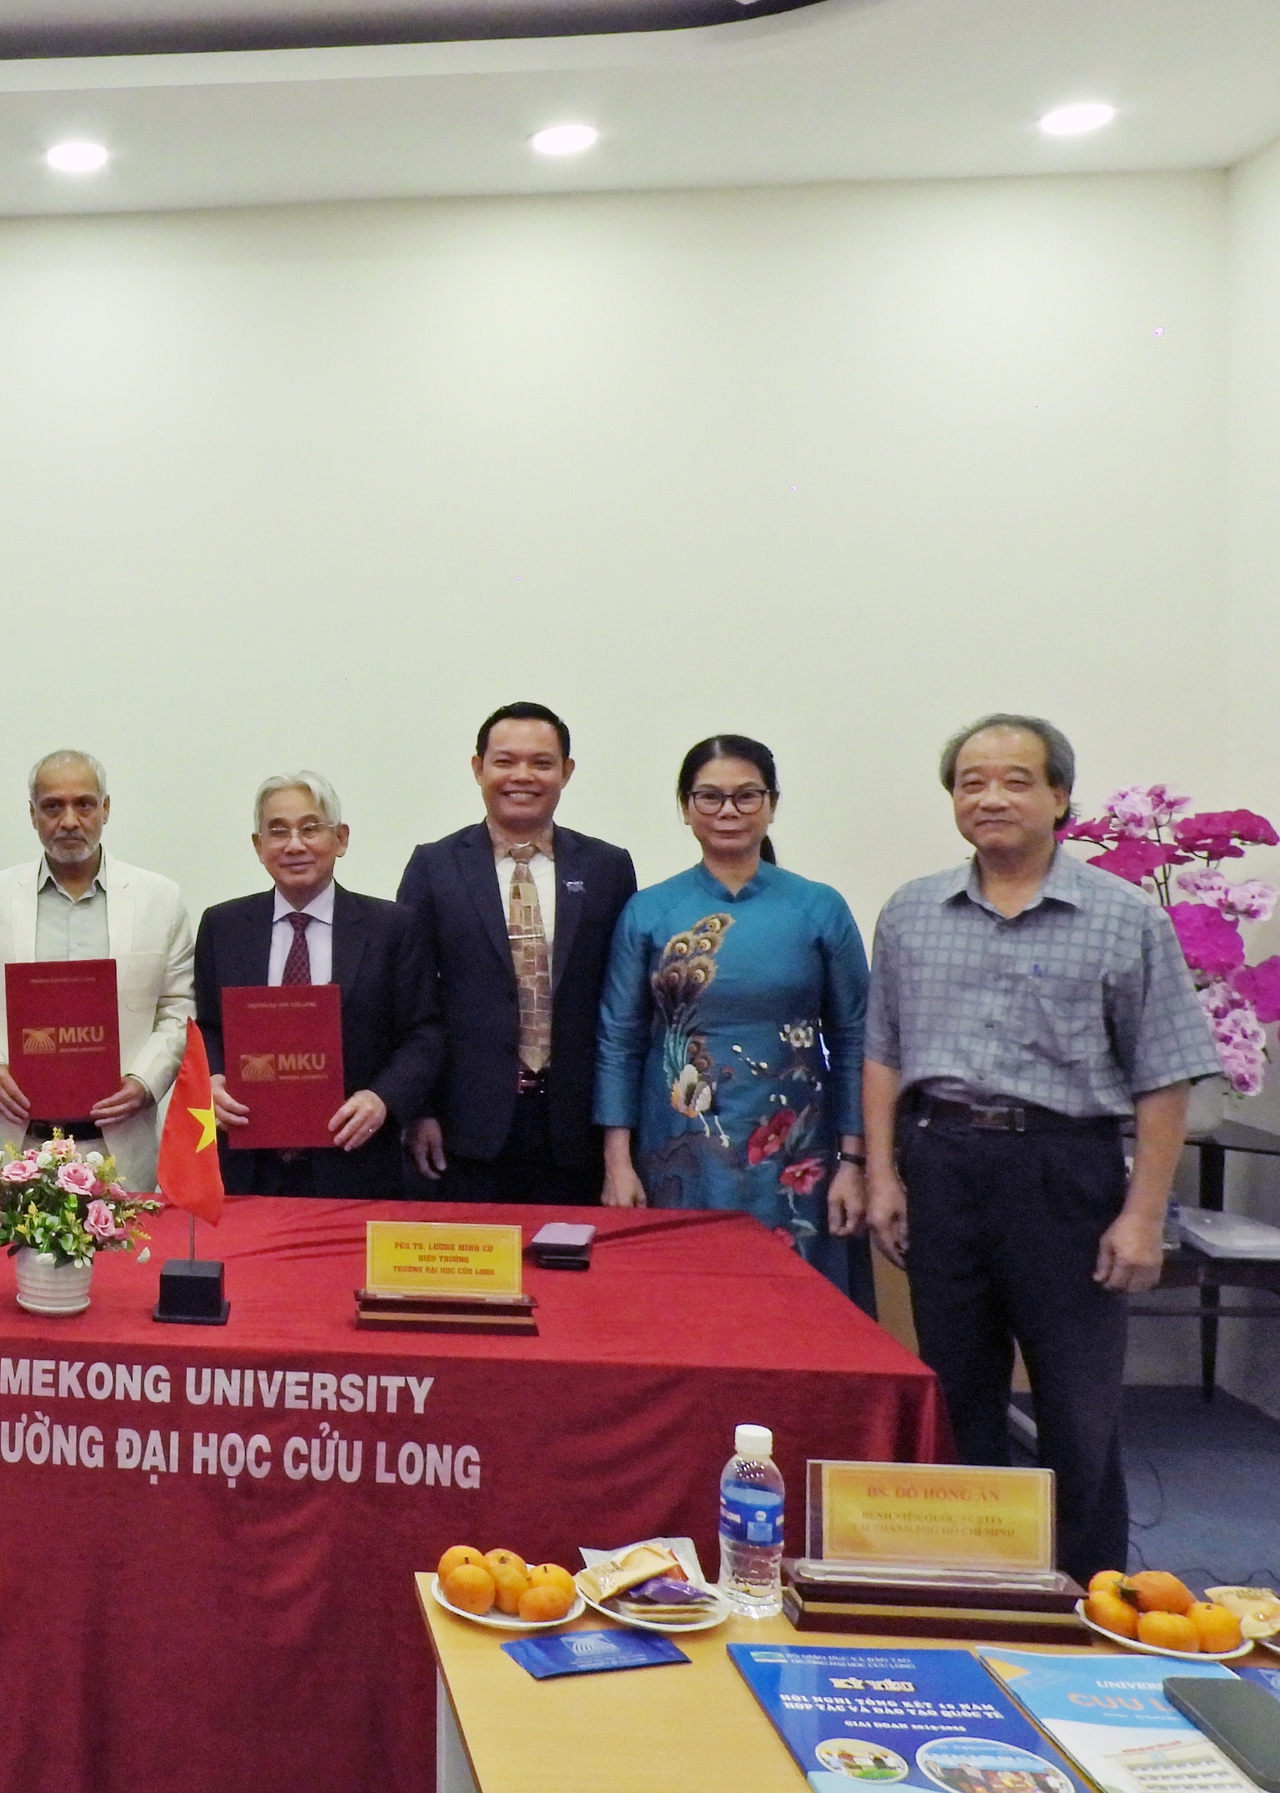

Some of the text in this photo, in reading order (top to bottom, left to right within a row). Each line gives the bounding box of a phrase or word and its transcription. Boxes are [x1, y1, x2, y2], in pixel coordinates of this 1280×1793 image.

[59, 1026, 104, 1043] MKU
[278, 1053, 325, 1070] MKU
[0, 1357, 435, 1414] MEKONG UNIVERSITY
[116, 1428, 179, 1485] ĐẠI
[193, 1432, 271, 1488] HỌC
[283, 1422, 363, 1483] CỬU
[375, 1441, 481, 1489] LONG
